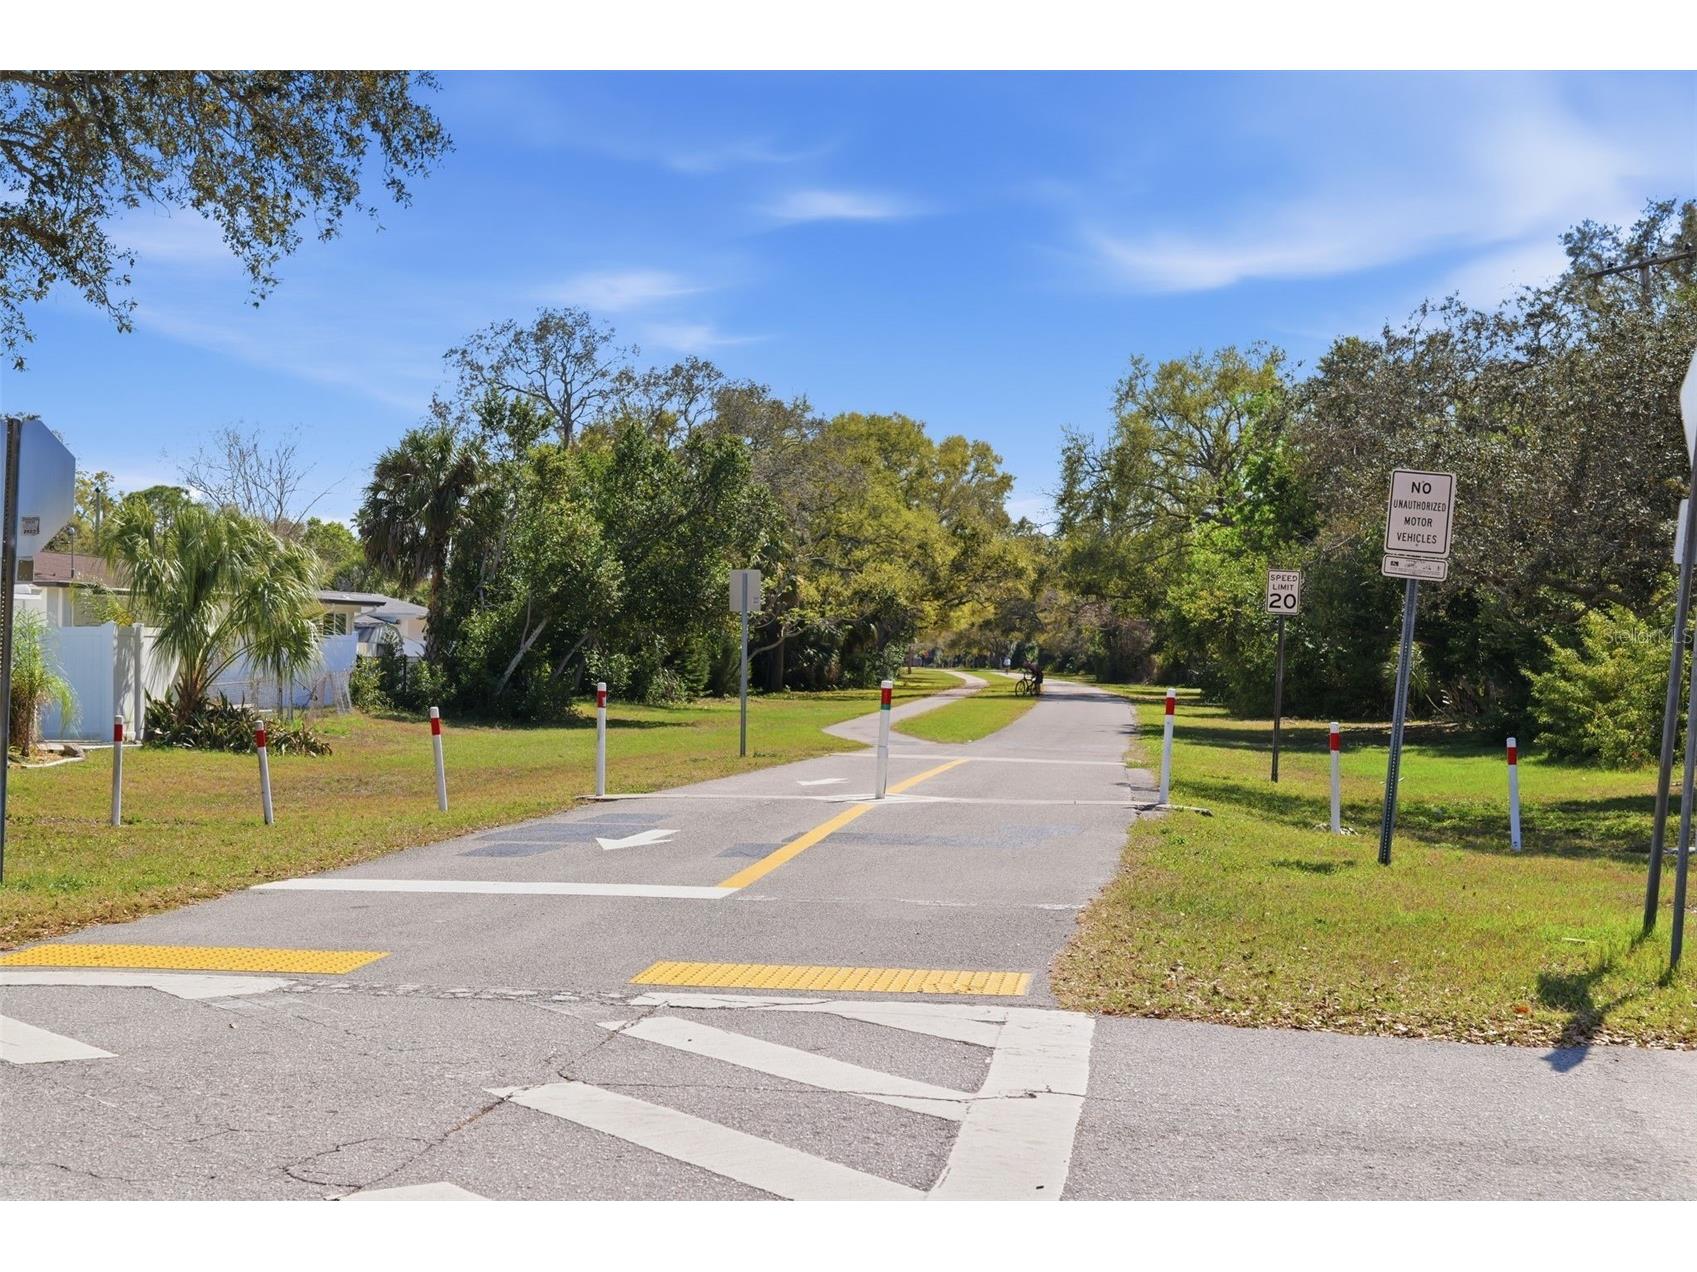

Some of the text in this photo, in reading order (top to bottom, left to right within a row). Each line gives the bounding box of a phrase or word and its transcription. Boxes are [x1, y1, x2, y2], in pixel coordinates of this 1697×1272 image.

[1411, 481, 1432, 494] NO
[1393, 500, 1447, 512] UNAUTHORIZED
[1403, 516, 1433, 527] MOTOR
[1396, 532, 1438, 544] VEHICLES
[1270, 574, 1298, 582] SPEED
[1272, 583, 1294, 591] LIMIT
[1269, 593, 1297, 609] 20
